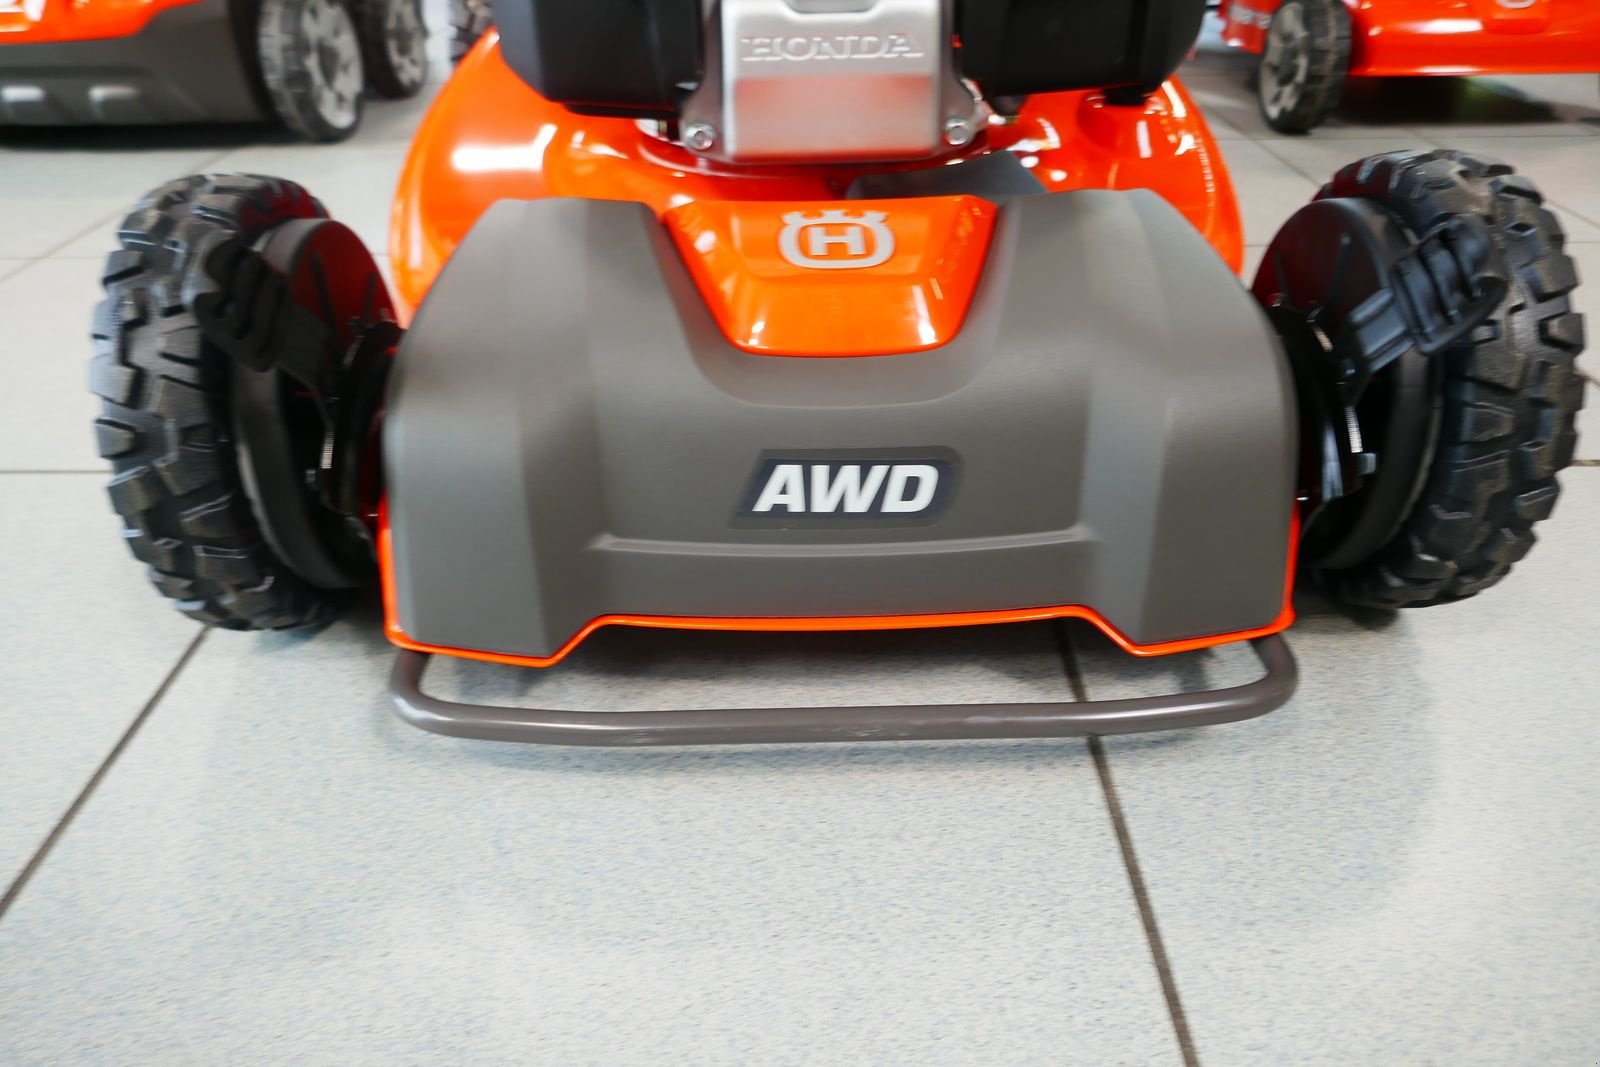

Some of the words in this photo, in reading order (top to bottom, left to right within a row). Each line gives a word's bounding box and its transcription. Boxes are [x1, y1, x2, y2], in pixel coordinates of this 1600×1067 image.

[740, 33, 925, 61] HONDA
[808, 226, 867, 256] H
[752, 464, 939, 513] AWD
